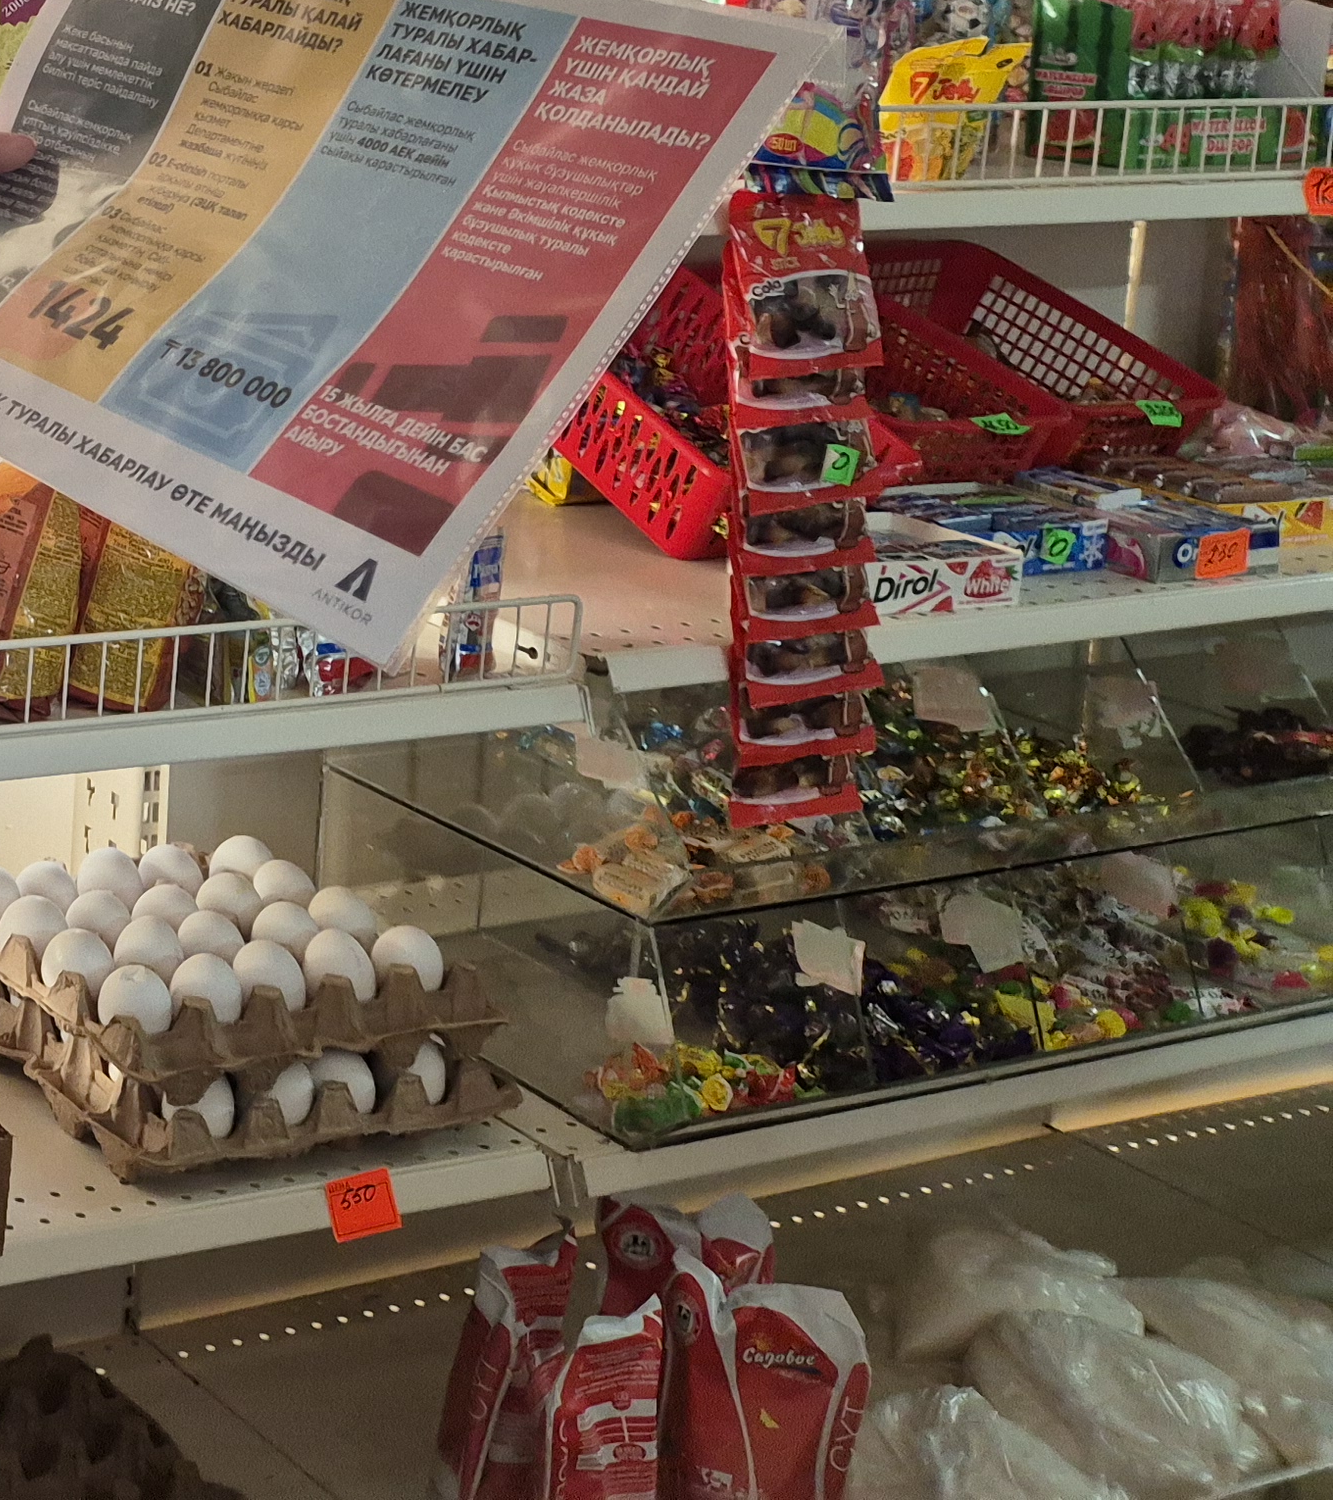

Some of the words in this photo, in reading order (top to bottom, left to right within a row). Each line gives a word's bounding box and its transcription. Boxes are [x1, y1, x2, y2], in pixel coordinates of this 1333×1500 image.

[218, 11, 343, 53] ХАБАРЛАЙДЫ?
[301, 6, 363, 32] ҚАЛАЙ
[399, 0, 528, 42] ЖЕМҚОРЛЫҚ
[390, 22, 463, 53] ТУРАЛЫ
[465, 38, 539, 67] ХАБАР-
[574, 34, 716, 81] ЖЕМҚОРЛЫҚ
[194, 60, 213, 77] 01
[376, 43, 454, 74] ЛАҒАНЫ
[455, 59, 508, 86] ҮШІН
[565, 57, 618, 84] ҮШІН
[618, 66, 711, 101] ҚАНДАЙ
[365, 65, 491, 106] КӨТЕРМЕЛЕУ
[548, 81, 608, 107] ЖАЗА
[338, 115, 379, 134] туралы
[347, 100, 404, 124] Сыбайлас
[534, 101, 712, 152] ҚОЛДАНЫЛАДЫ?
[148, 151, 165, 168] 02
[357, 136, 389, 152] 4000
[389, 144, 416, 160] АЕК
[513, 139, 577, 164] Сыбайлас
[580, 152, 659, 183] жемқорлық
[101, 205, 122, 219] 03
[472, 201, 506, 218] және
[560, 202, 626, 228] кодексте
[451, 230, 512, 255] кодексте
[539, 234, 589, 257] туралы
[751, 279, 782, 298] Cola
[29, 279, 135, 351] 1424
[175, 343, 204, 371] 13
[197, 358, 246, 389] 800
[243, 376, 292, 409] 000
[283, 426, 346, 458] АЙЫРУ
[300, 403, 452, 478] БОСТАНДЫҒЫНАН
[337, 390, 399, 426] ЖЫЛҒА
[397, 415, 448, 451] ДЕЙІН
[447, 437, 488, 464] БАС
[0, 397, 79, 448] ТУРАЛЫ
[72, 431, 173, 493] ХАБАРЛАУ
[169, 481, 215, 516] ӨТЕ
[209, 501, 328, 572] МАҢЫЗДЫ
[874, 568, 940, 604] Dirol
[965, 572, 1011, 597] White
[311, 587, 373, 627] ANTIKOR
[339, 1184, 377, 1211] 550
